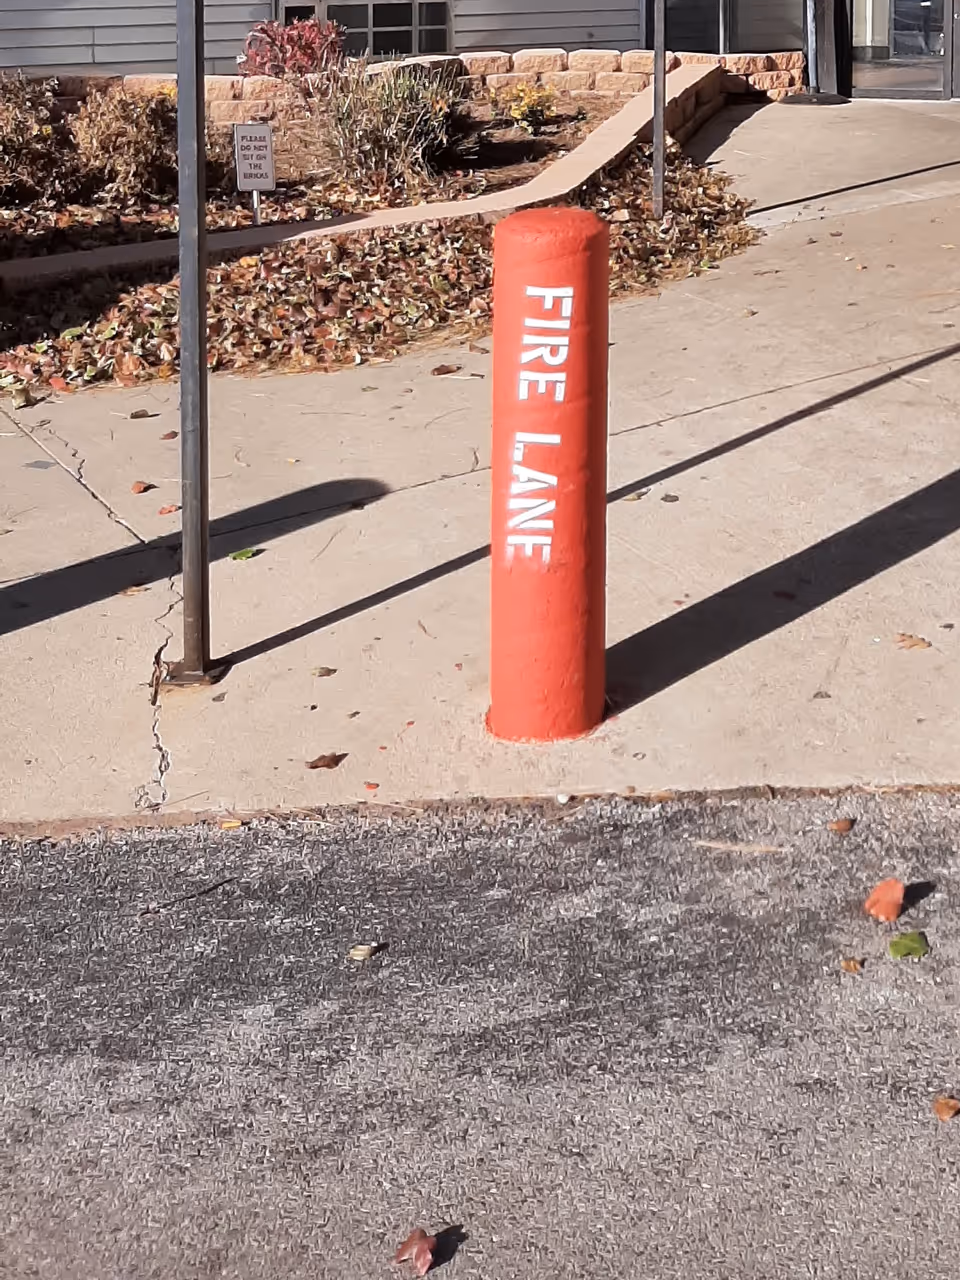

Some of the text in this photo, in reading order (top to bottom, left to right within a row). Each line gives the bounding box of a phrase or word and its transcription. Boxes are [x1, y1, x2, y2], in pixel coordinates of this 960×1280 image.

[248, 162, 263, 170] THE
[505, 285, 574, 568] FIRE LANE
